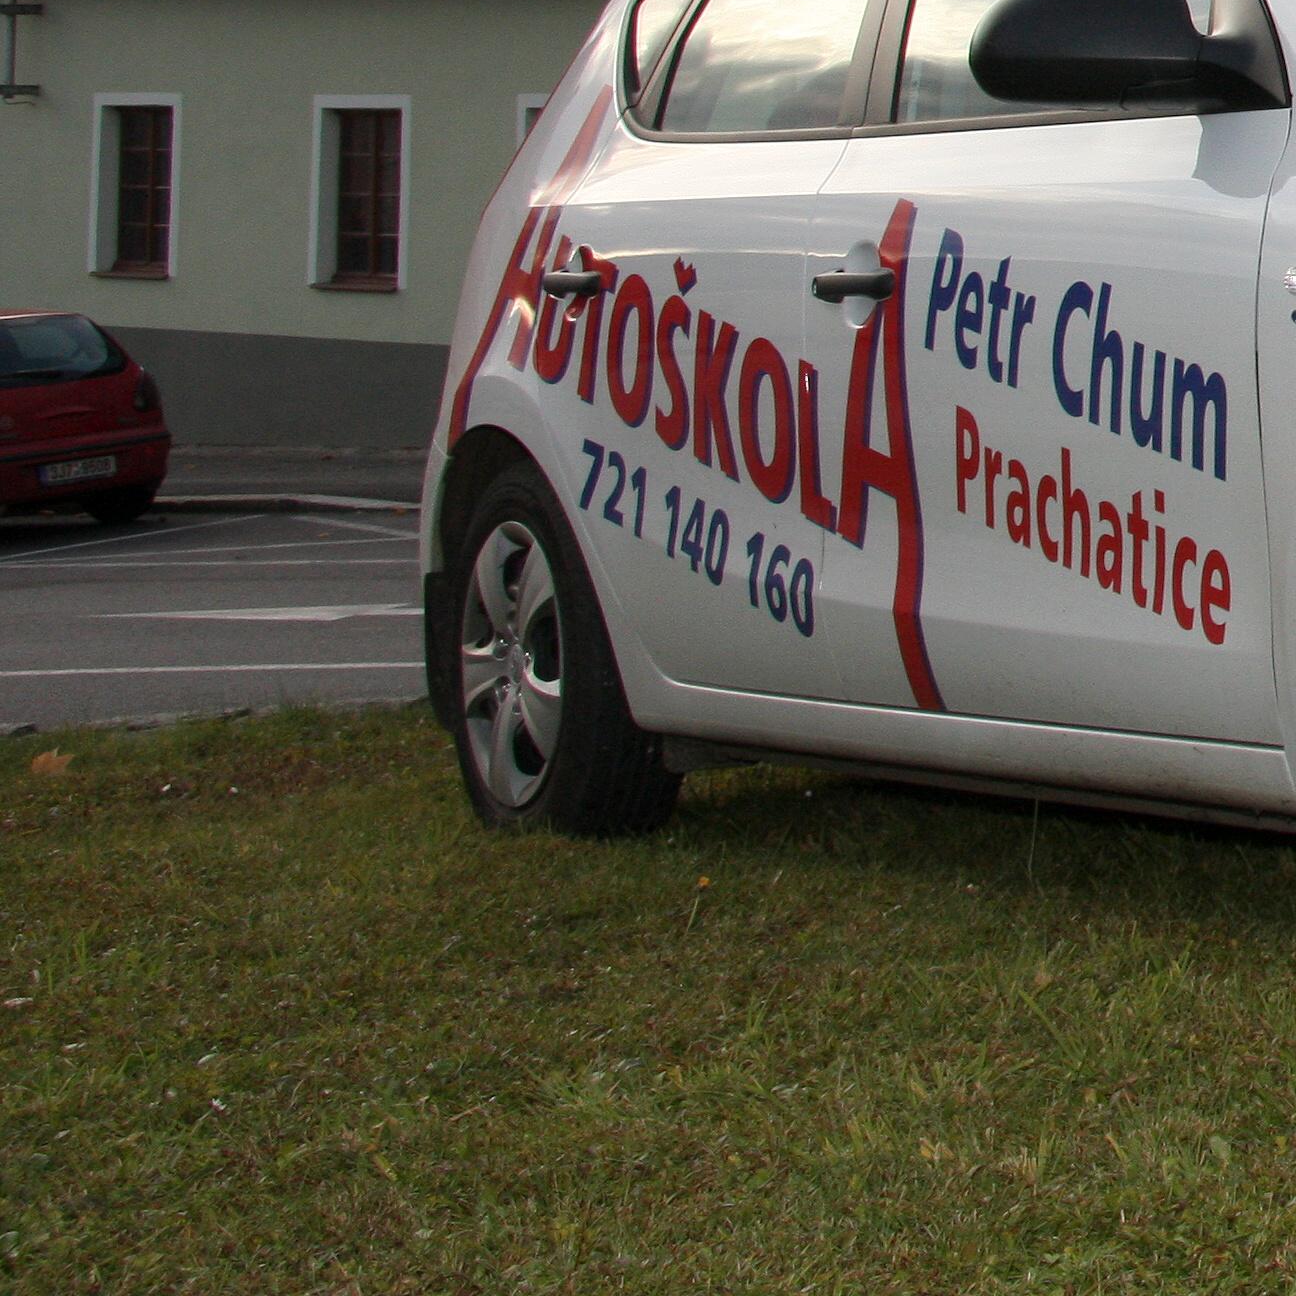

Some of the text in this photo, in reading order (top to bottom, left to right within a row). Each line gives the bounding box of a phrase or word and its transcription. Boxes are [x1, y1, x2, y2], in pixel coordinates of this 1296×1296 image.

[448, 84, 946, 712] AUTOŠKOLA
[924, 226, 1229, 482] Petr Chum
[577, 438, 815, 638] 721 140 160
[955, 405, 1233, 646] Prachatice
